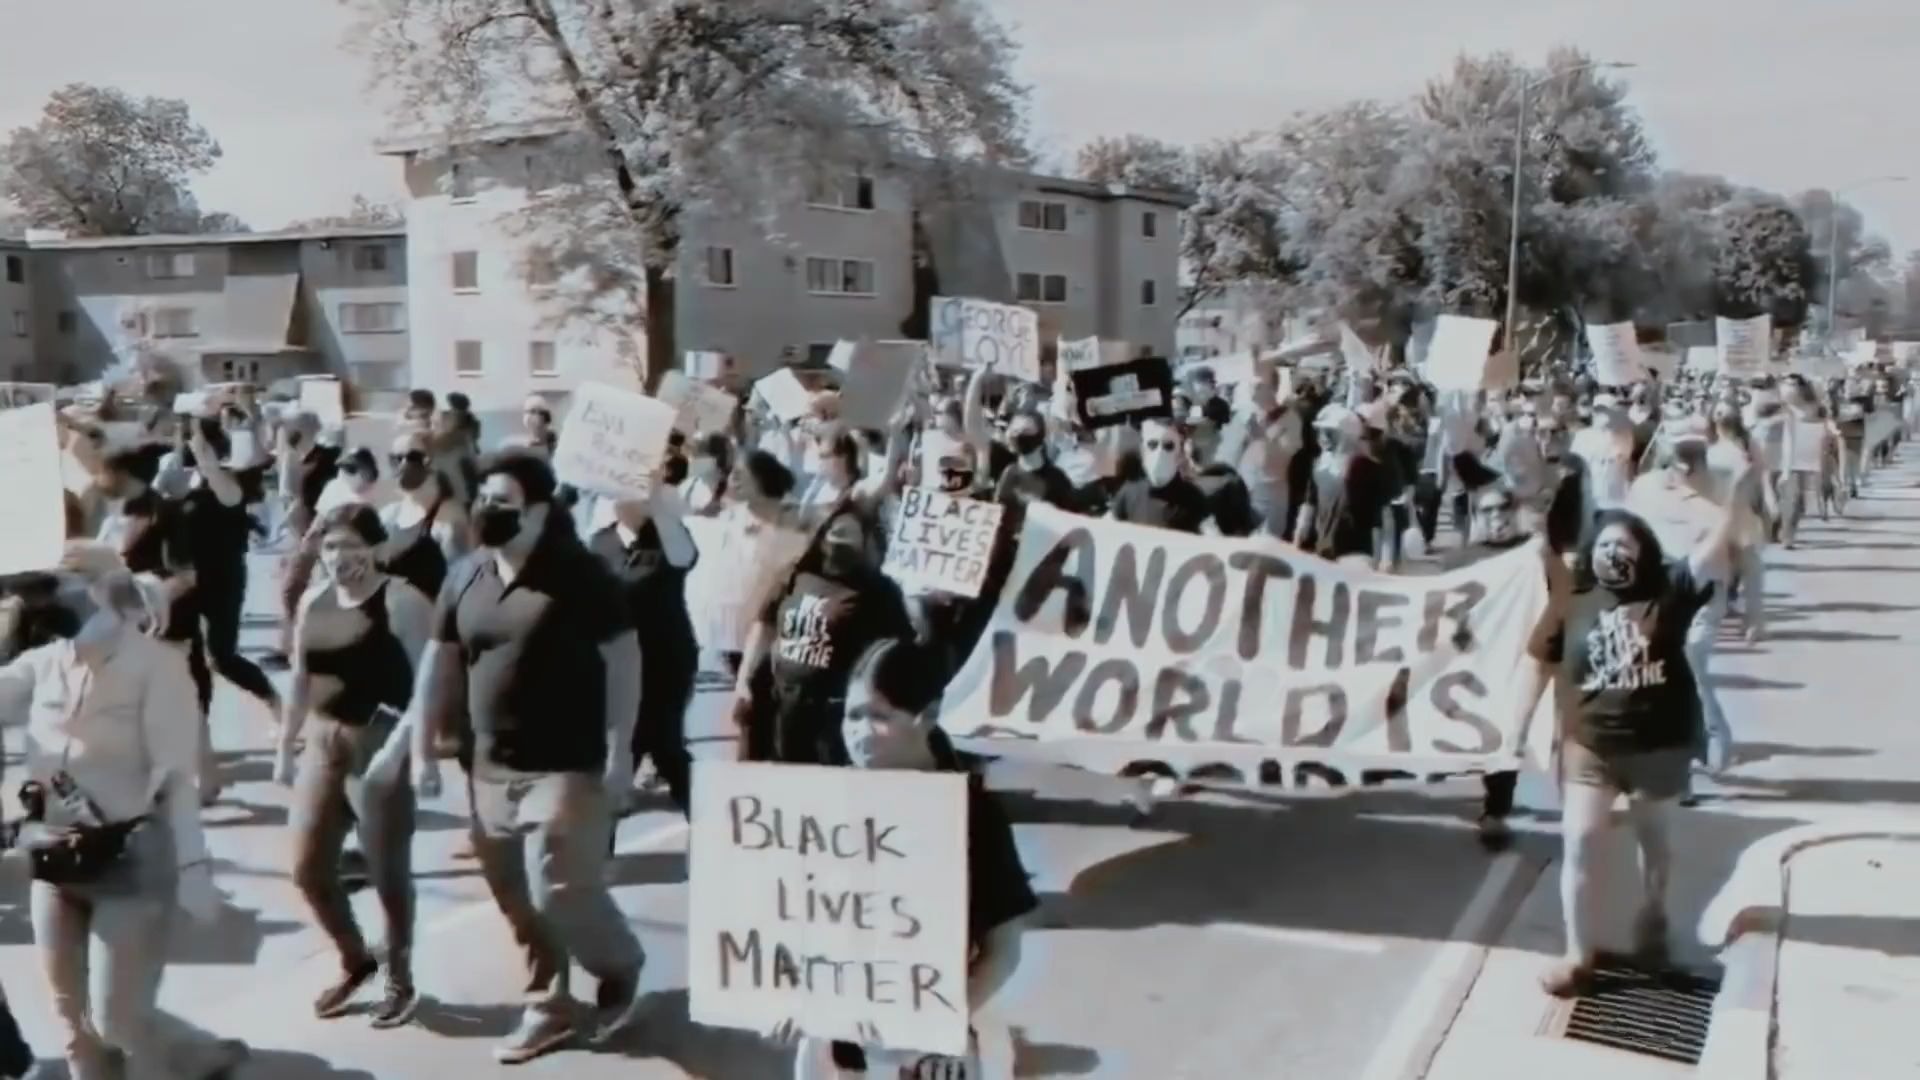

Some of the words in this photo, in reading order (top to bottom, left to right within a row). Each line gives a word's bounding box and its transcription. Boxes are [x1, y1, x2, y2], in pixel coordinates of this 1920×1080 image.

[897, 522, 990, 557] LIVES
[1014, 527, 1486, 671] ANOTHER
[990, 630, 1349, 747] WORLD
[1386, 667, 1504, 755] IS
[729, 795, 906, 863] BLACK
[718, 929, 958, 1013] MATTER
